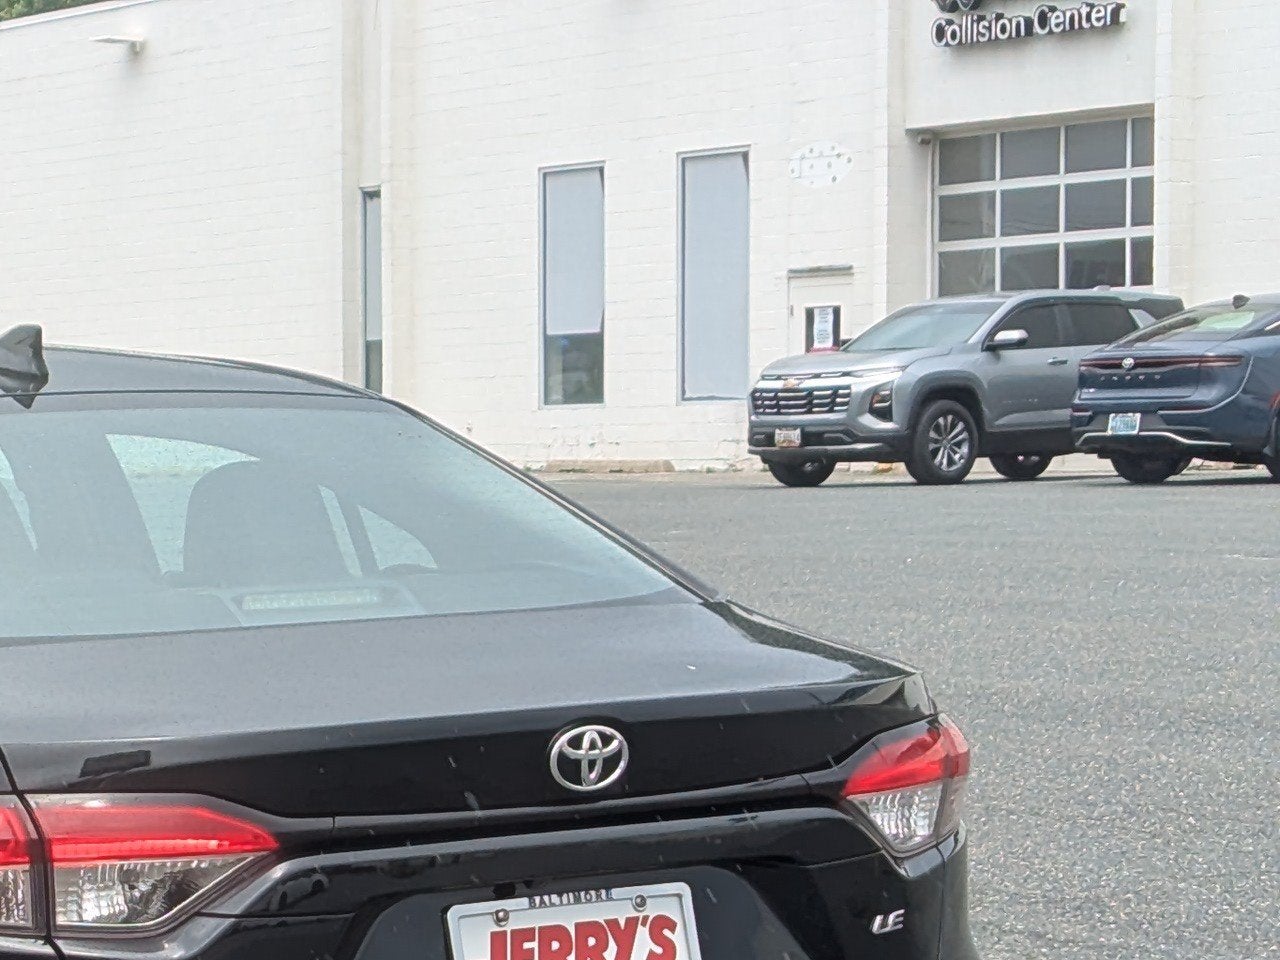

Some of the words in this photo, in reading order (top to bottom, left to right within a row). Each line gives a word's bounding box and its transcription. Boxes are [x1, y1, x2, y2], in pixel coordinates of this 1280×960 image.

[931, 13, 1028, 47] Collision
[1033, 2, 1120, 34] Center
[872, 909, 905, 935] LE
